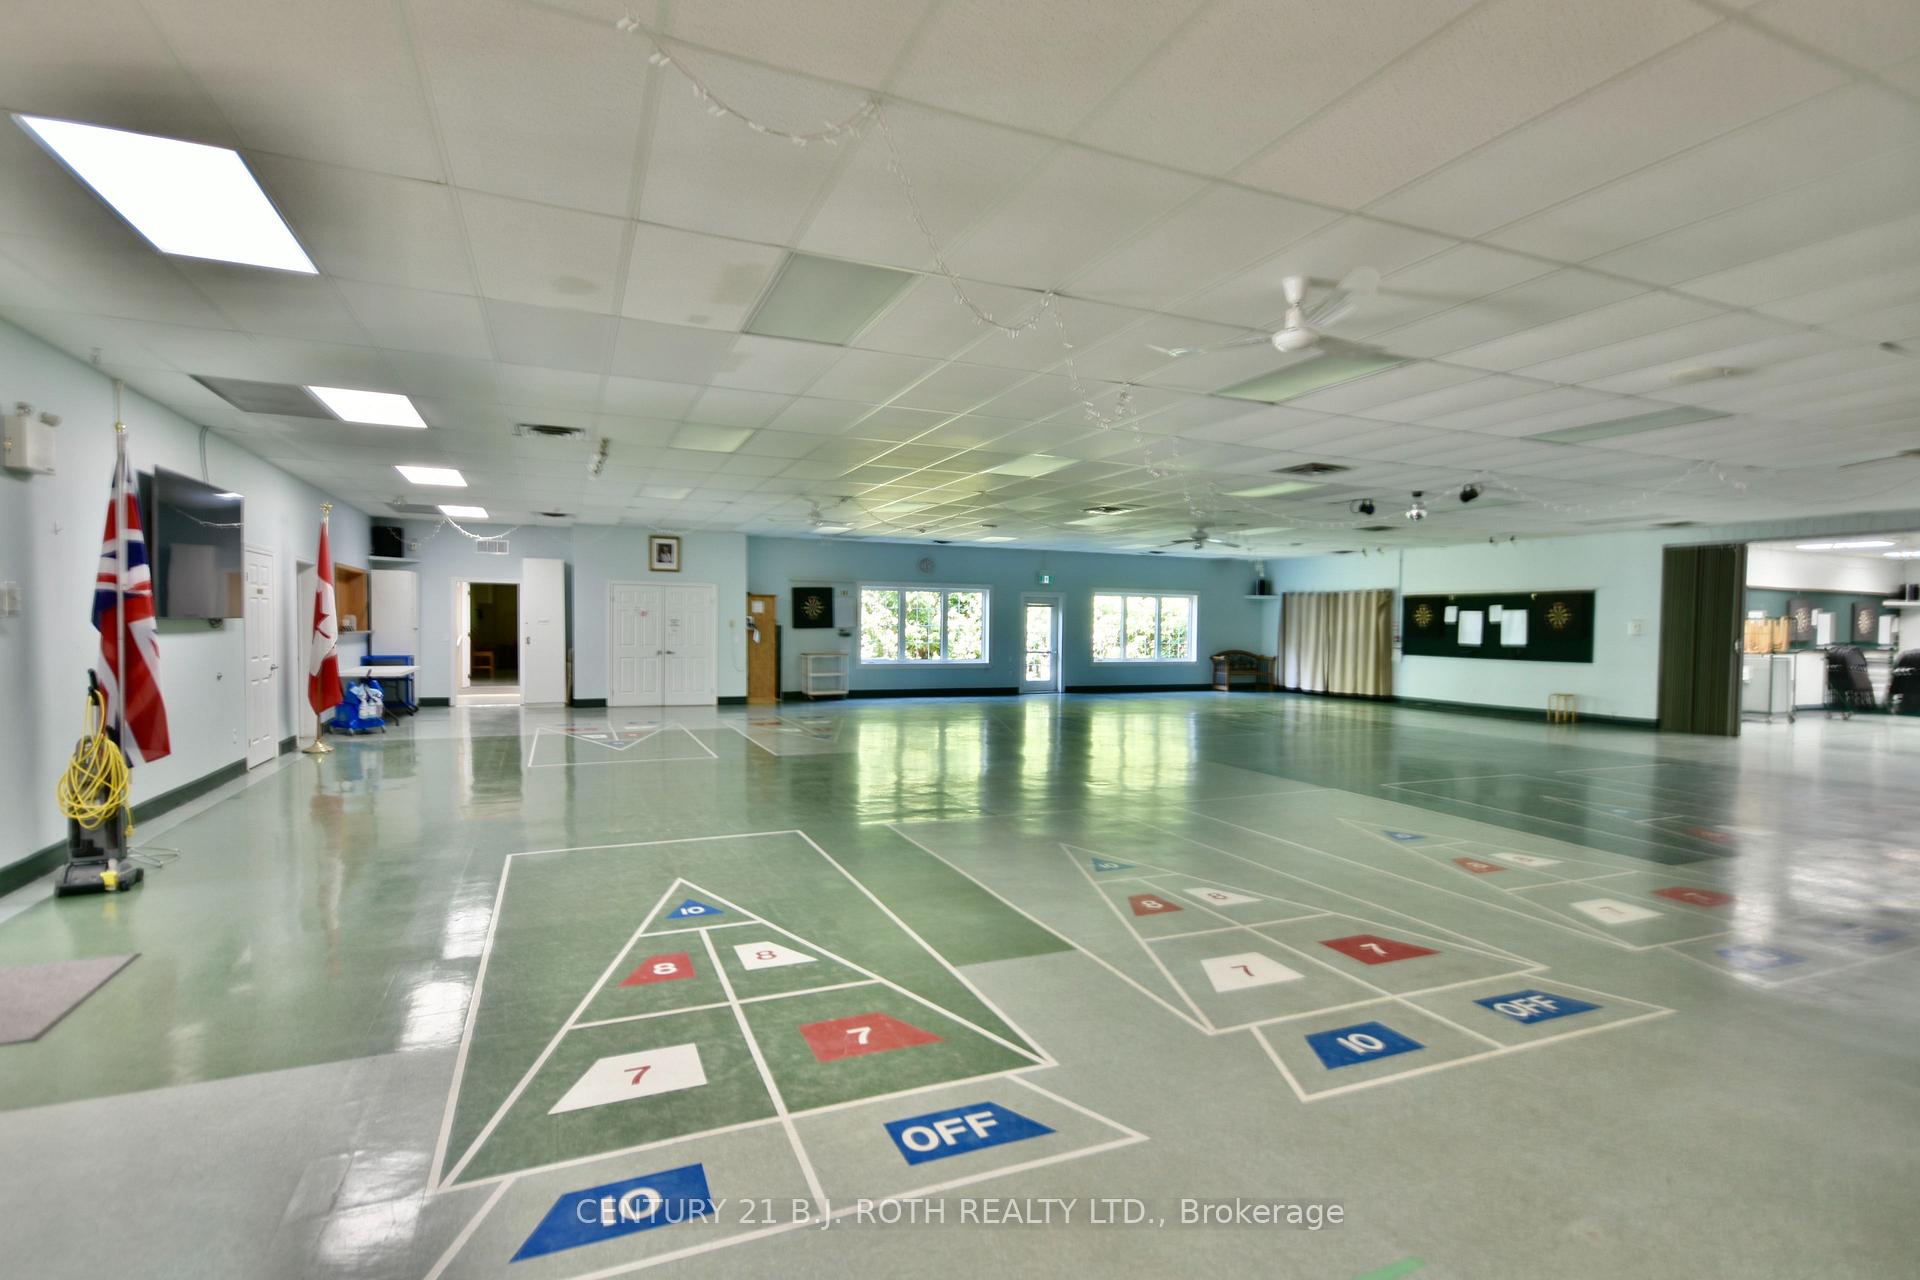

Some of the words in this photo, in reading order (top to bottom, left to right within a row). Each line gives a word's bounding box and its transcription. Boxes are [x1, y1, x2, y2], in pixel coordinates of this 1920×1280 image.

[679, 905, 706, 916] 10
[755, 949, 777, 961] 8
[1360, 943, 1389, 956] 7
[652, 962, 678, 976] 8
[1230, 965, 1255, 977] 7
[1493, 994, 1560, 1019] OFF
[846, 1025, 872, 1046] 7
[1336, 1032, 1386, 1056] 10
[624, 1065, 652, 1085] 7
[901, 1110, 1000, 1154] OFF
[600, 1186, 662, 1228] 10
